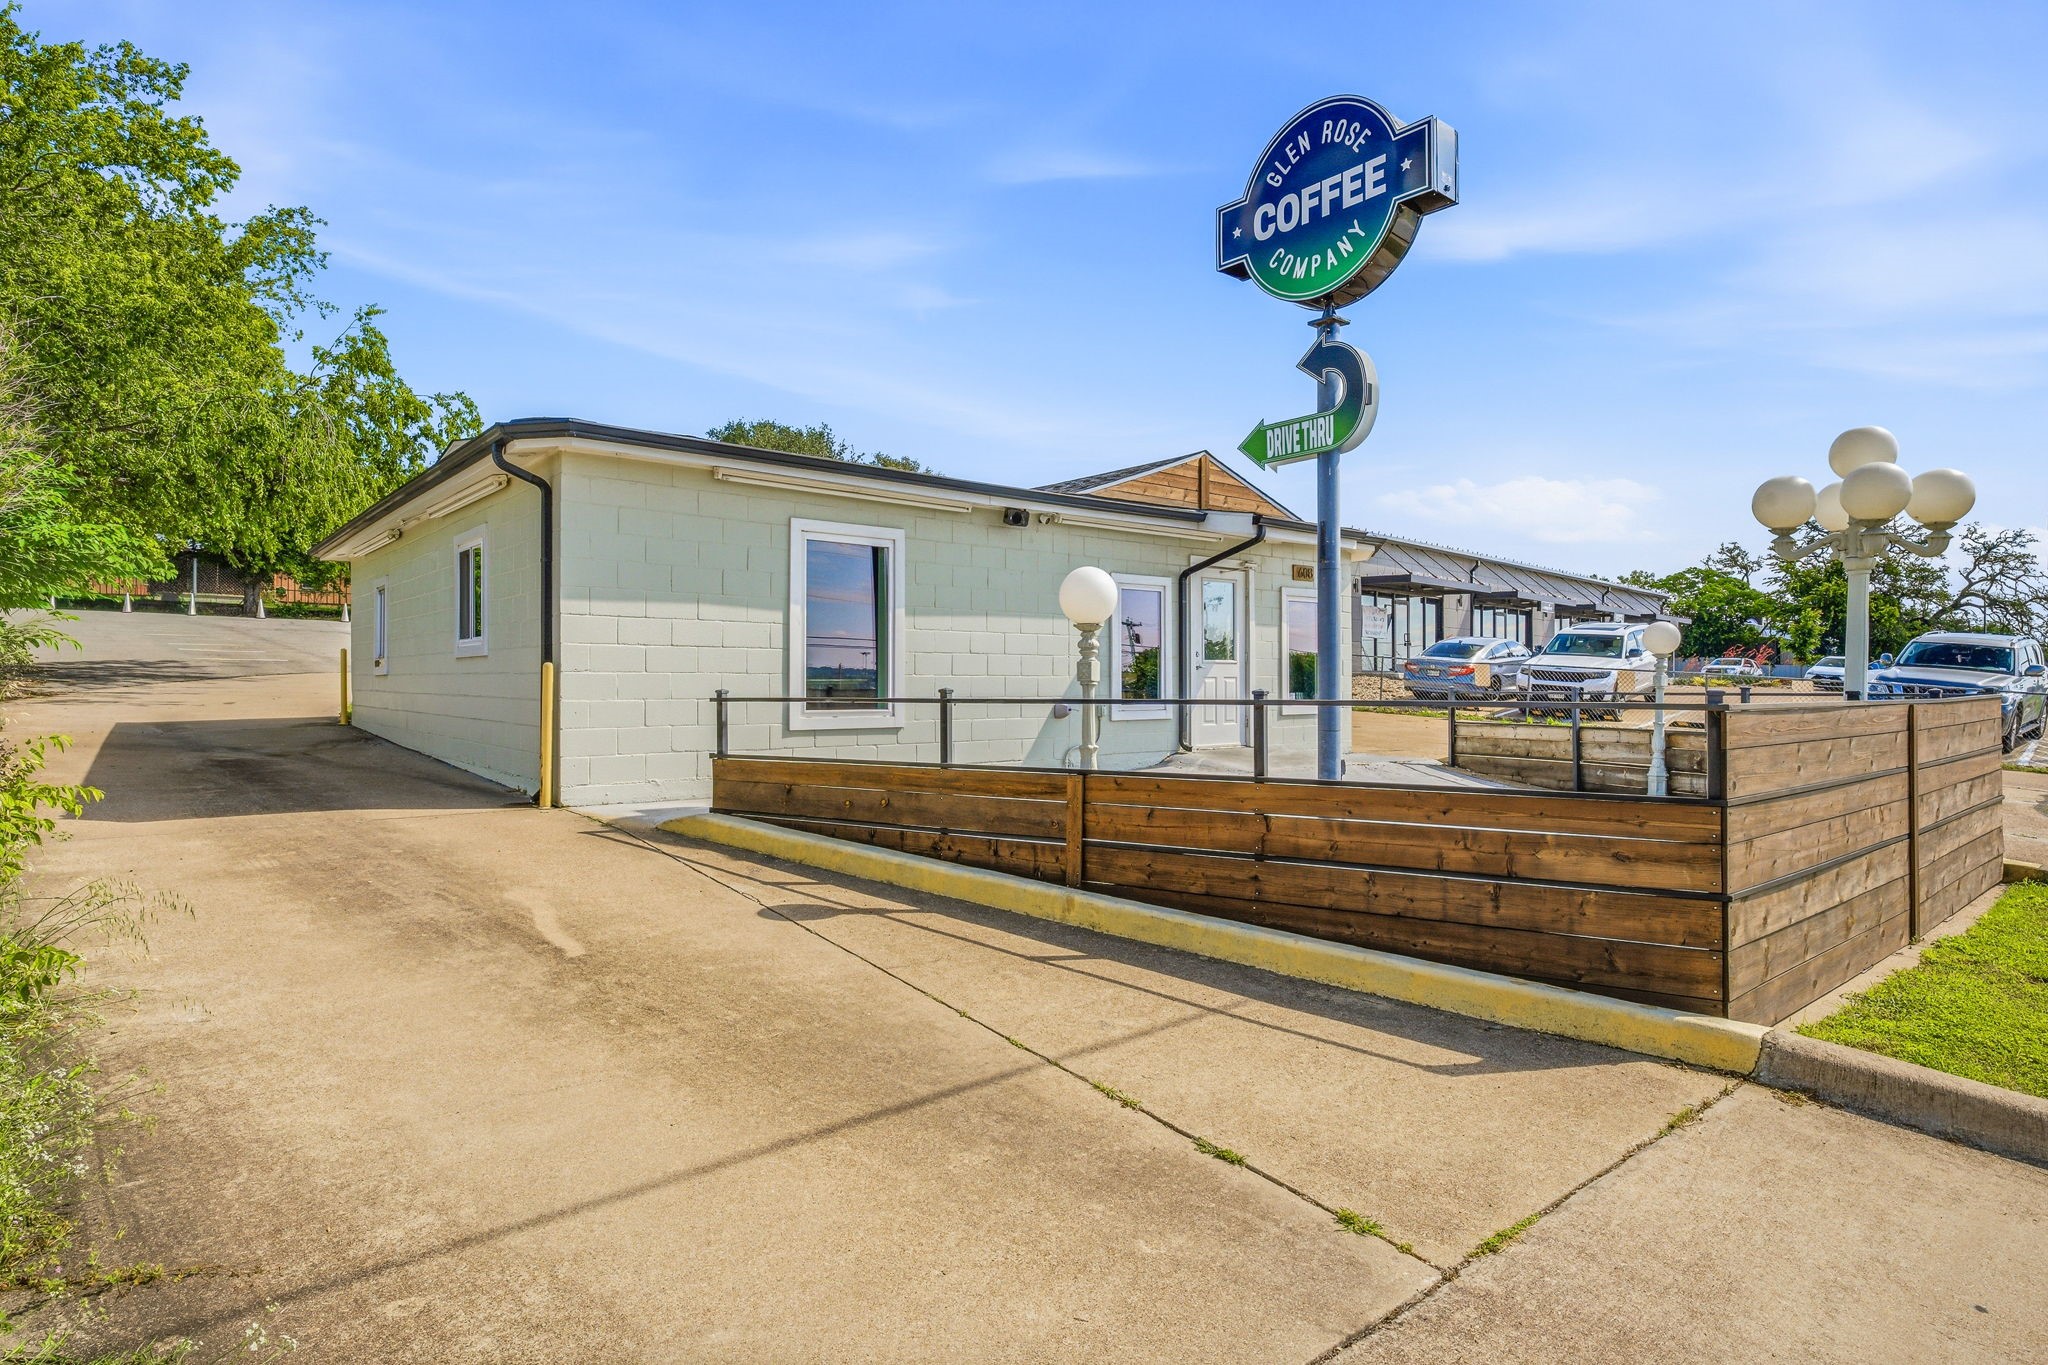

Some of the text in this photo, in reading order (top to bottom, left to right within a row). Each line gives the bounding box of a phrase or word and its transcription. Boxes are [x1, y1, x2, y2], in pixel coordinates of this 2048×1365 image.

[1267, 118, 1372, 187] GLEN ROSE
[1253, 154, 1387, 241] COFFEE
[1269, 219, 1366, 279] COMPANY
[1266, 414, 1335, 459] DRIVE THRU
